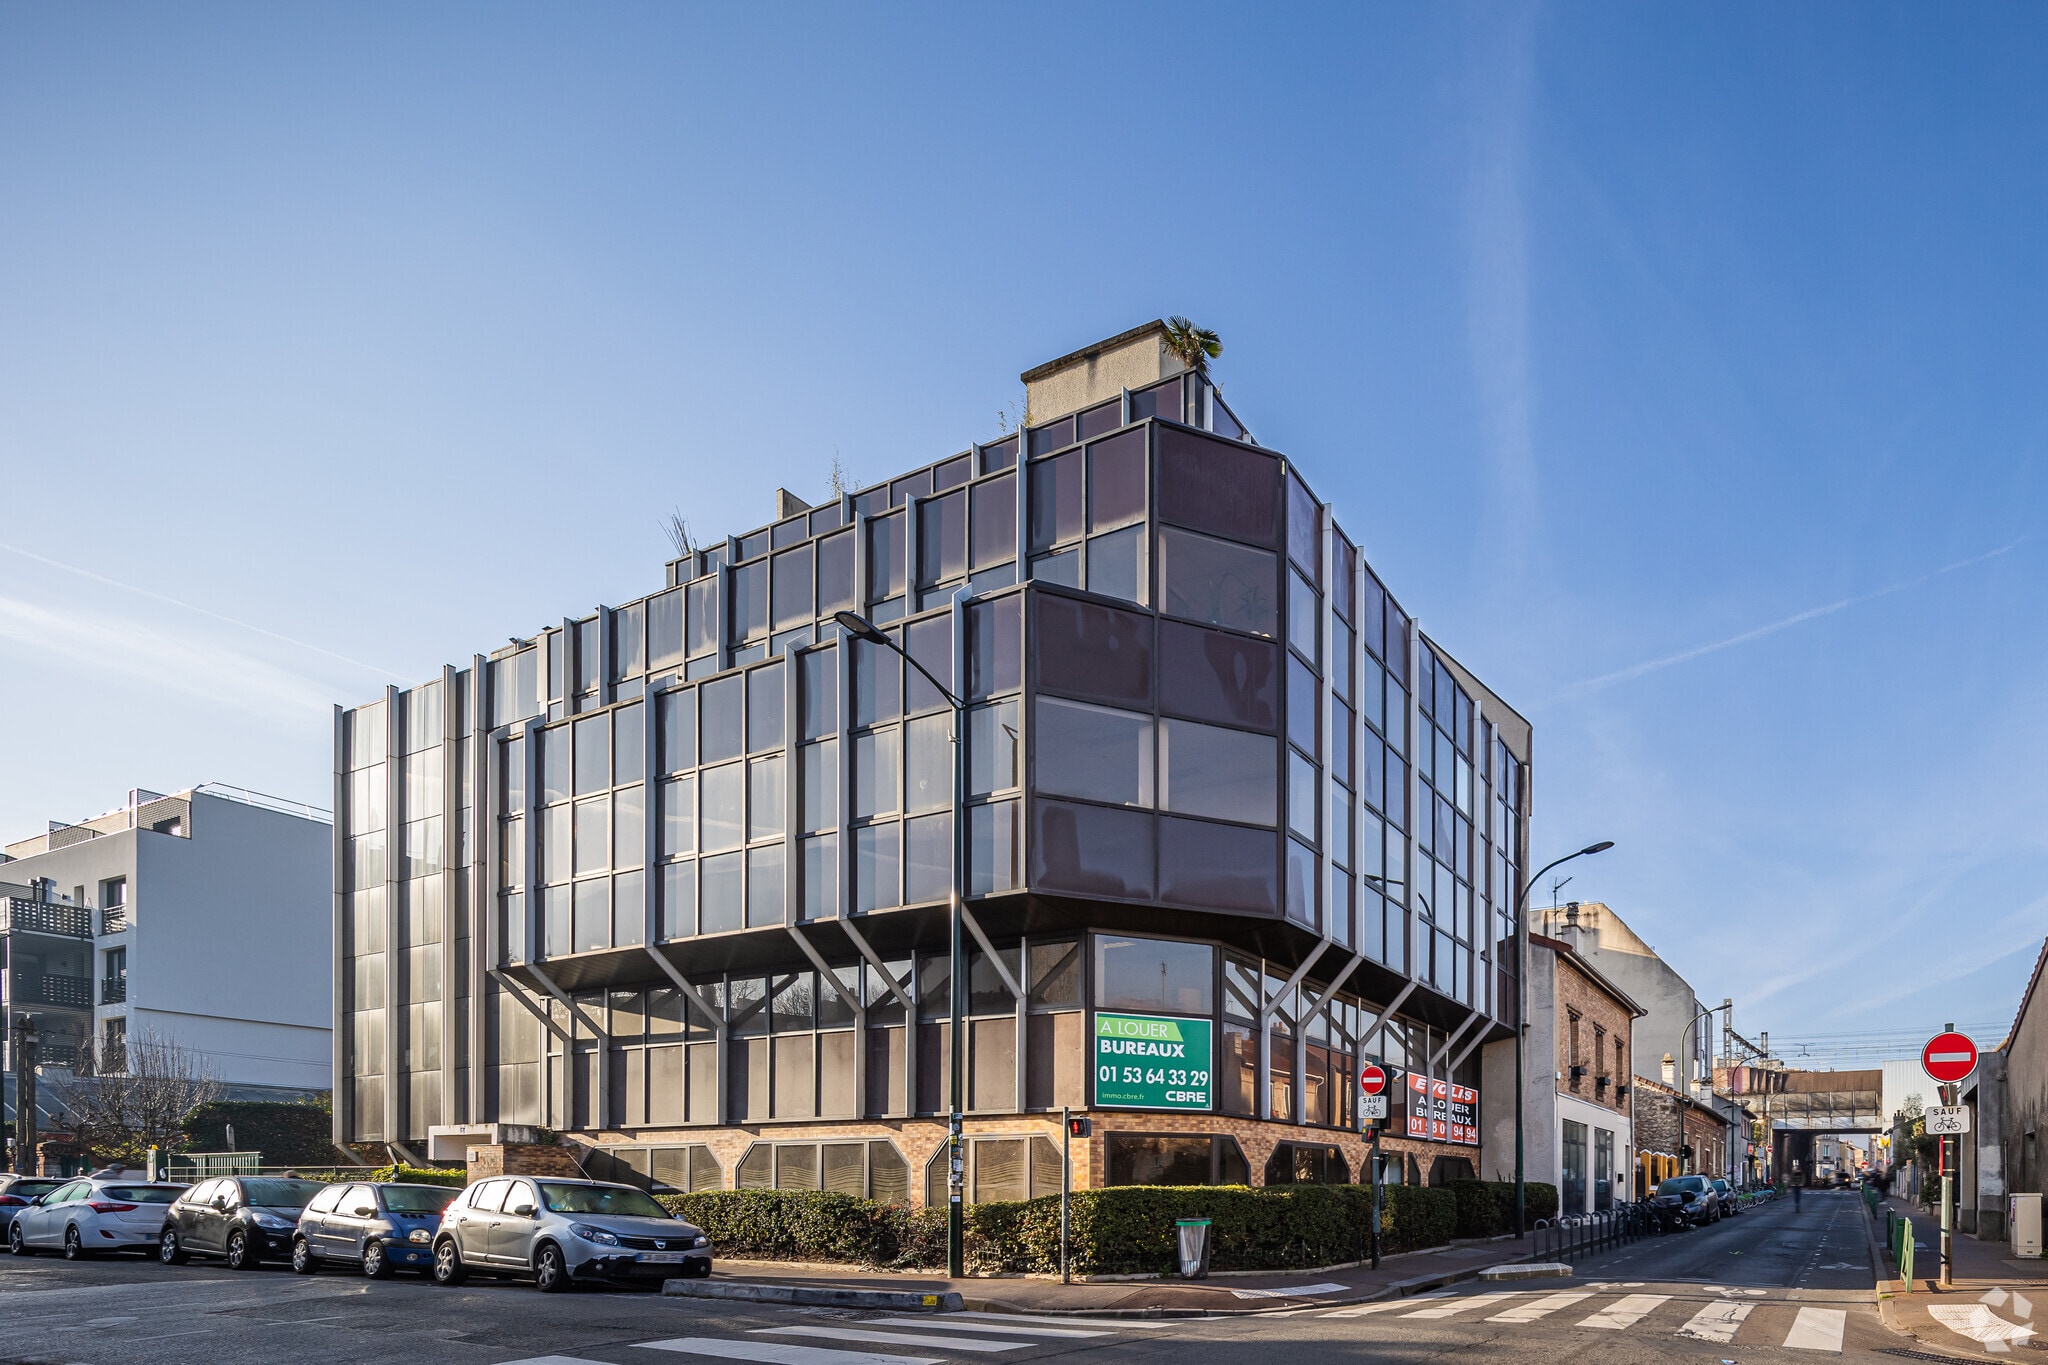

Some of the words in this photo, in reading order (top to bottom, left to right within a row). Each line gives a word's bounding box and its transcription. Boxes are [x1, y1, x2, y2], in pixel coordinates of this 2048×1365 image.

[1100, 1022, 1113, 1034] A
[1118, 1021, 1168, 1038] LOUER
[1100, 1039, 1185, 1058] BUREAUX
[1099, 1065, 1117, 1082] 01
[1122, 1066, 1142, 1084] 53
[1145, 1068, 1165, 1085] 64
[1168, 1069, 1187, 1086] 33
[1190, 1070, 1208, 1087] 29
[1102, 1092, 1145, 1100] immo.cbre.fr
[1165, 1090, 1206, 1103] CBRE
[1415, 1077, 1472, 1101] EVOLIS
[1363, 1096, 1382, 1104] SAUF
[1418, 1095, 1427, 1106] A
[1933, 1107, 1961, 1116] SAUF
[1411, 1118, 1422, 1131] 01
[1453, 1125, 1463, 1137] 94
[1466, 1127, 1476, 1139] 94
[1879, 1137, 1891, 1148] M
